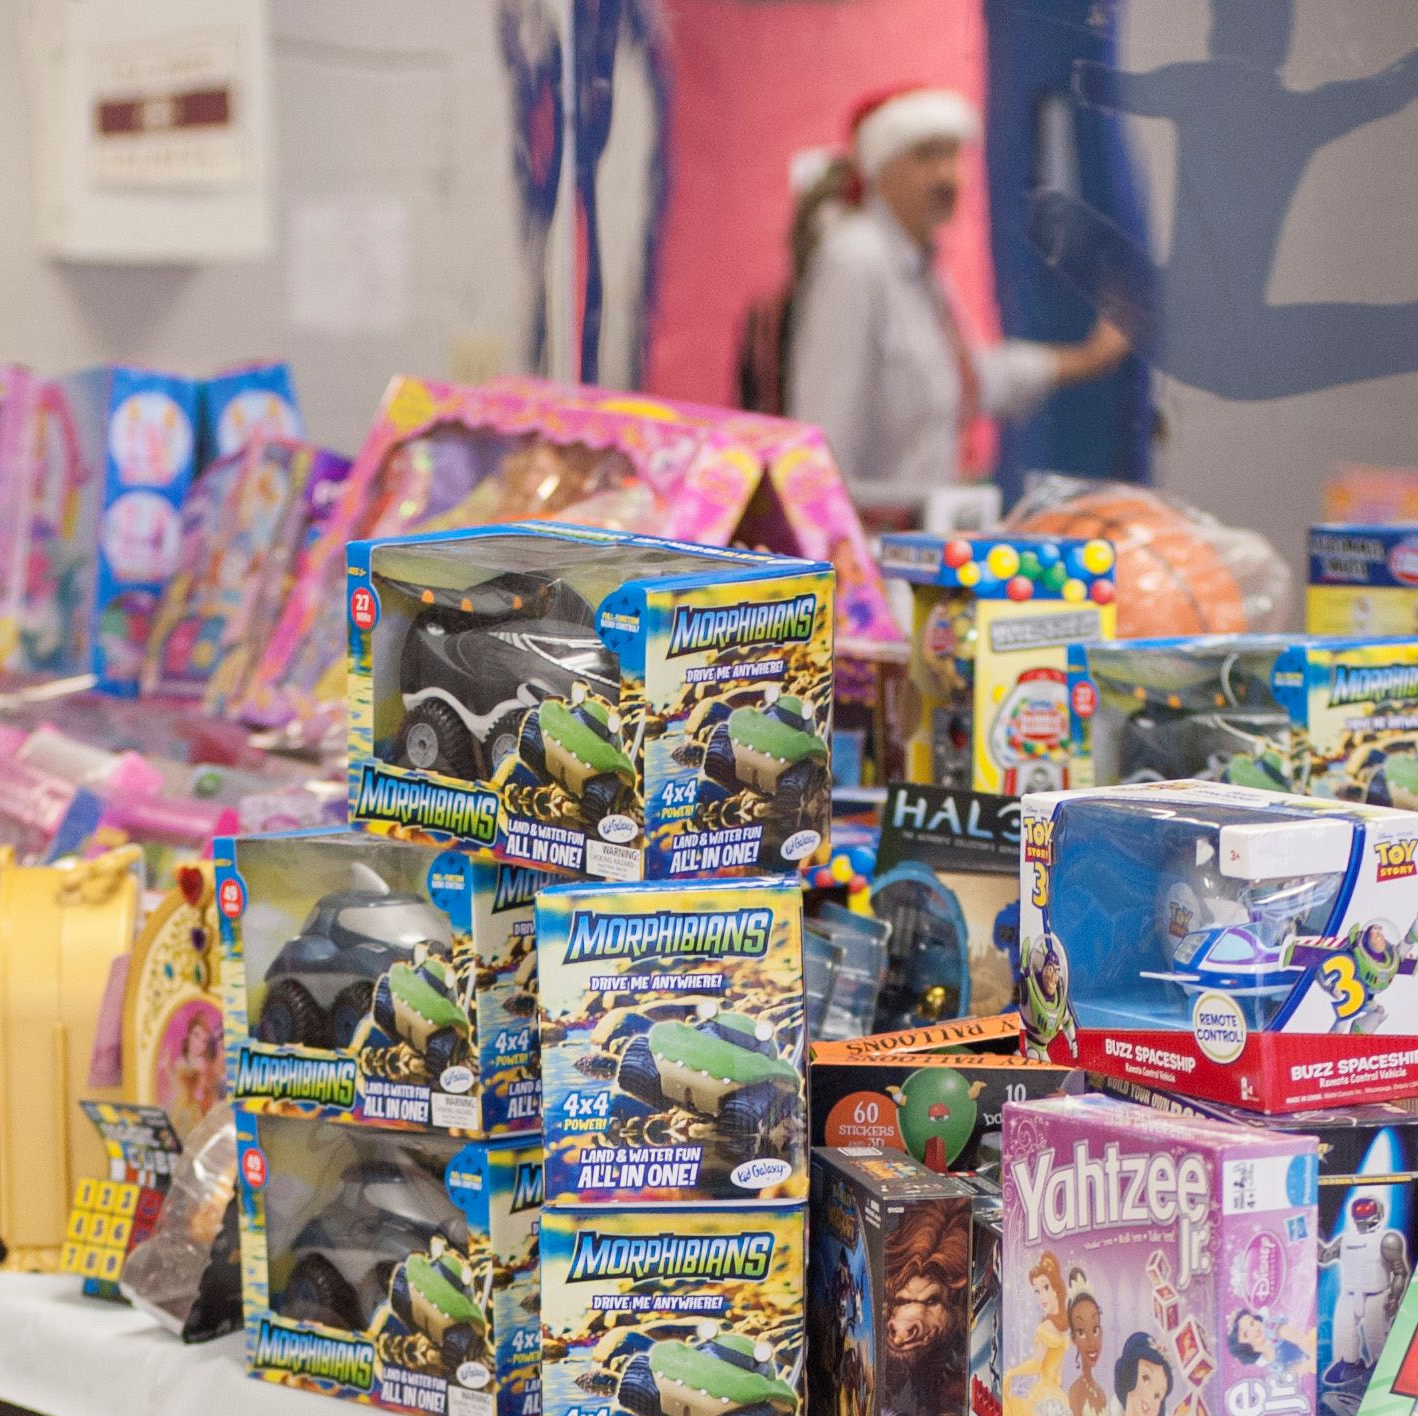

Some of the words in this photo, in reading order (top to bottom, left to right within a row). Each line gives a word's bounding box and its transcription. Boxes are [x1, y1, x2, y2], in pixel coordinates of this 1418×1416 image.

[356, 595, 369, 611] 27
[672, 598, 814, 652] MORPHIBIANS
[359, 771, 496, 841] MORPHIBIANS
[1024, 817, 1053, 846] TOY
[1375, 840, 1418, 867] TOY
[1380, 865, 1414, 877] STORY
[569, 910, 769, 962] MORPHIBIANS
[591, 977, 627, 990] DRIVE
[631, 976, 649, 990] ME
[652, 975, 722, 989] ANYWHERE!
[1324, 957, 1364, 1019] 3
[1200, 1014, 1238, 1027] REMOTE
[1197, 1029, 1244, 1044] CONTROL!
[1106, 1040, 1133, 1058] BUZZ
[1136, 1046, 1196, 1072] SPACESHIP
[1291, 1062, 1333, 1081] BUZZ
[1320, 1076, 1348, 1088] Remote
[1351, 1072, 1378, 1084] Control
[1380, 1067, 1407, 1080] Vehicle
[1005, 1084, 1026, 1101] 10
[854, 1102, 878, 1123] 60
[839, 1125, 894, 1136] STICKERS
[581, 1149, 614, 1162] LAND
[616, 1149, 626, 1162] &
[628, 1148, 673, 1162] WATER
[675, 1148, 701, 1161] FUN
[578, 1166, 617, 1188] ALL
[620, 1165, 644, 1187] IN
[648, 1164, 699, 1186] ONE!
[1011, 1141, 1210, 1247] Yahtzee
[572, 1236, 771, 1280] MORPHIBIANS
[594, 1297, 629, 1310] DRIVE
[633, 1296, 651, 1309] ME
[654, 1296, 723, 1309] ANYWHERE!
